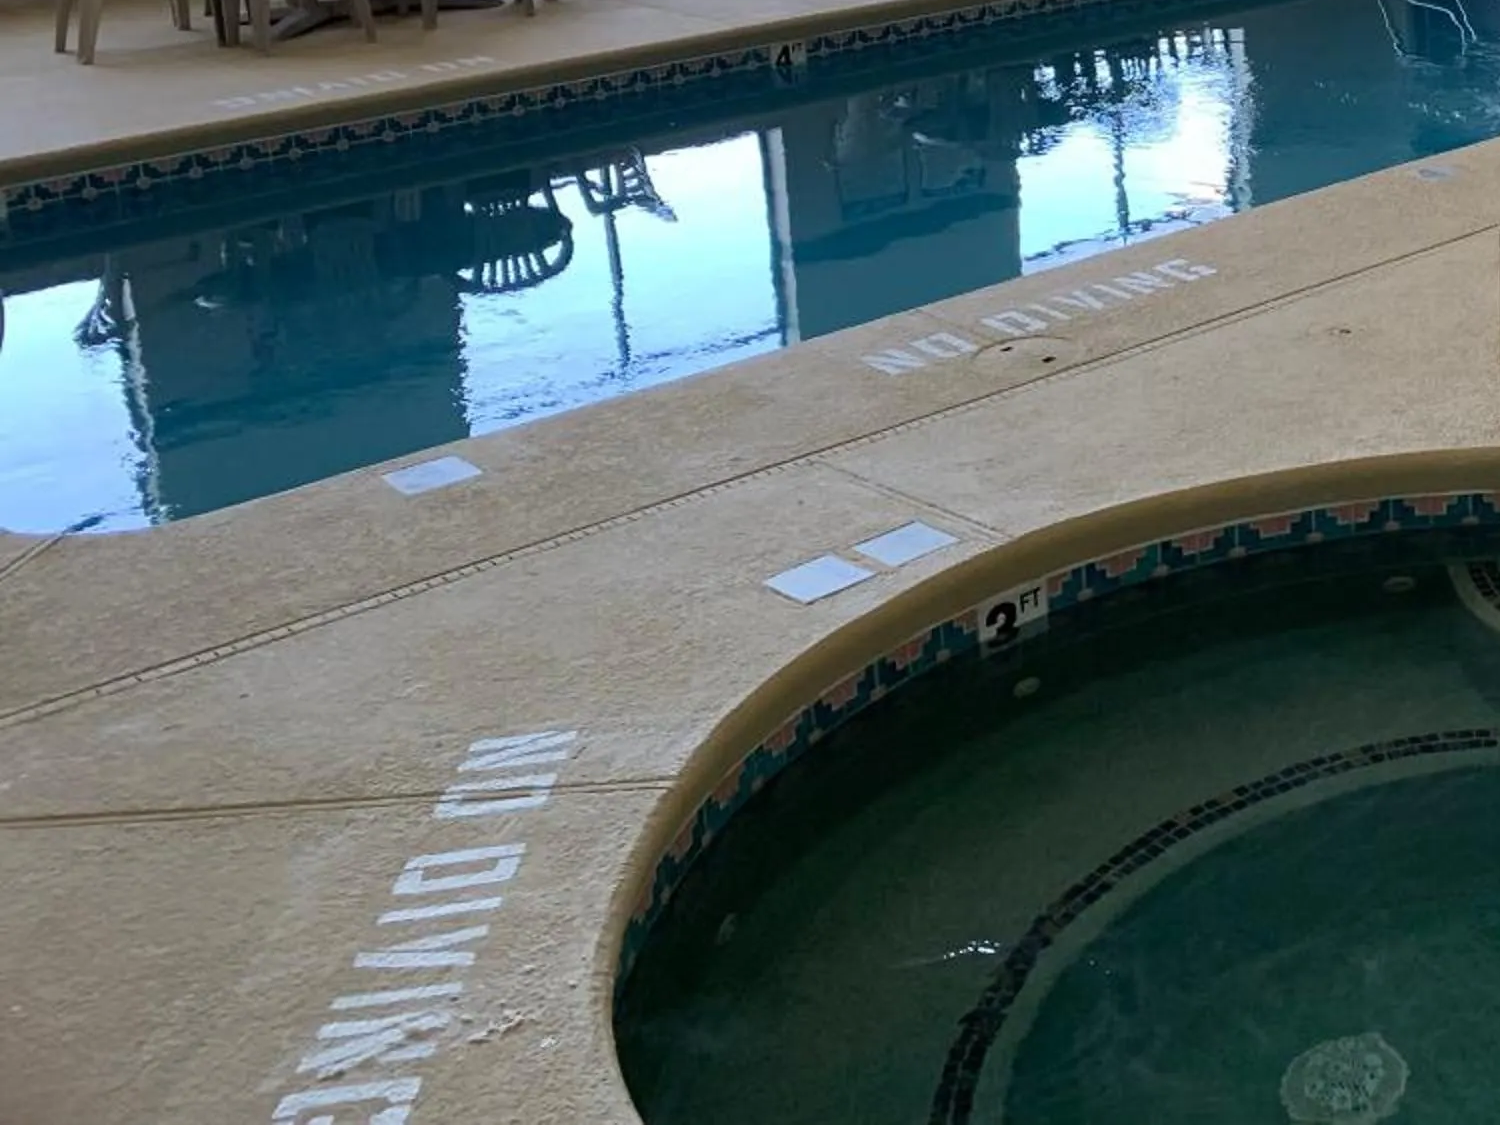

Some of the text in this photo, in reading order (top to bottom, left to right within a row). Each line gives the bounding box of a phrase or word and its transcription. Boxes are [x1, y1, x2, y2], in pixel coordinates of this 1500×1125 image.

[861, 258, 1218, 375] NO DIVING
[1019, 586, 1041, 614] FT
[433, 730, 578, 819] NO
